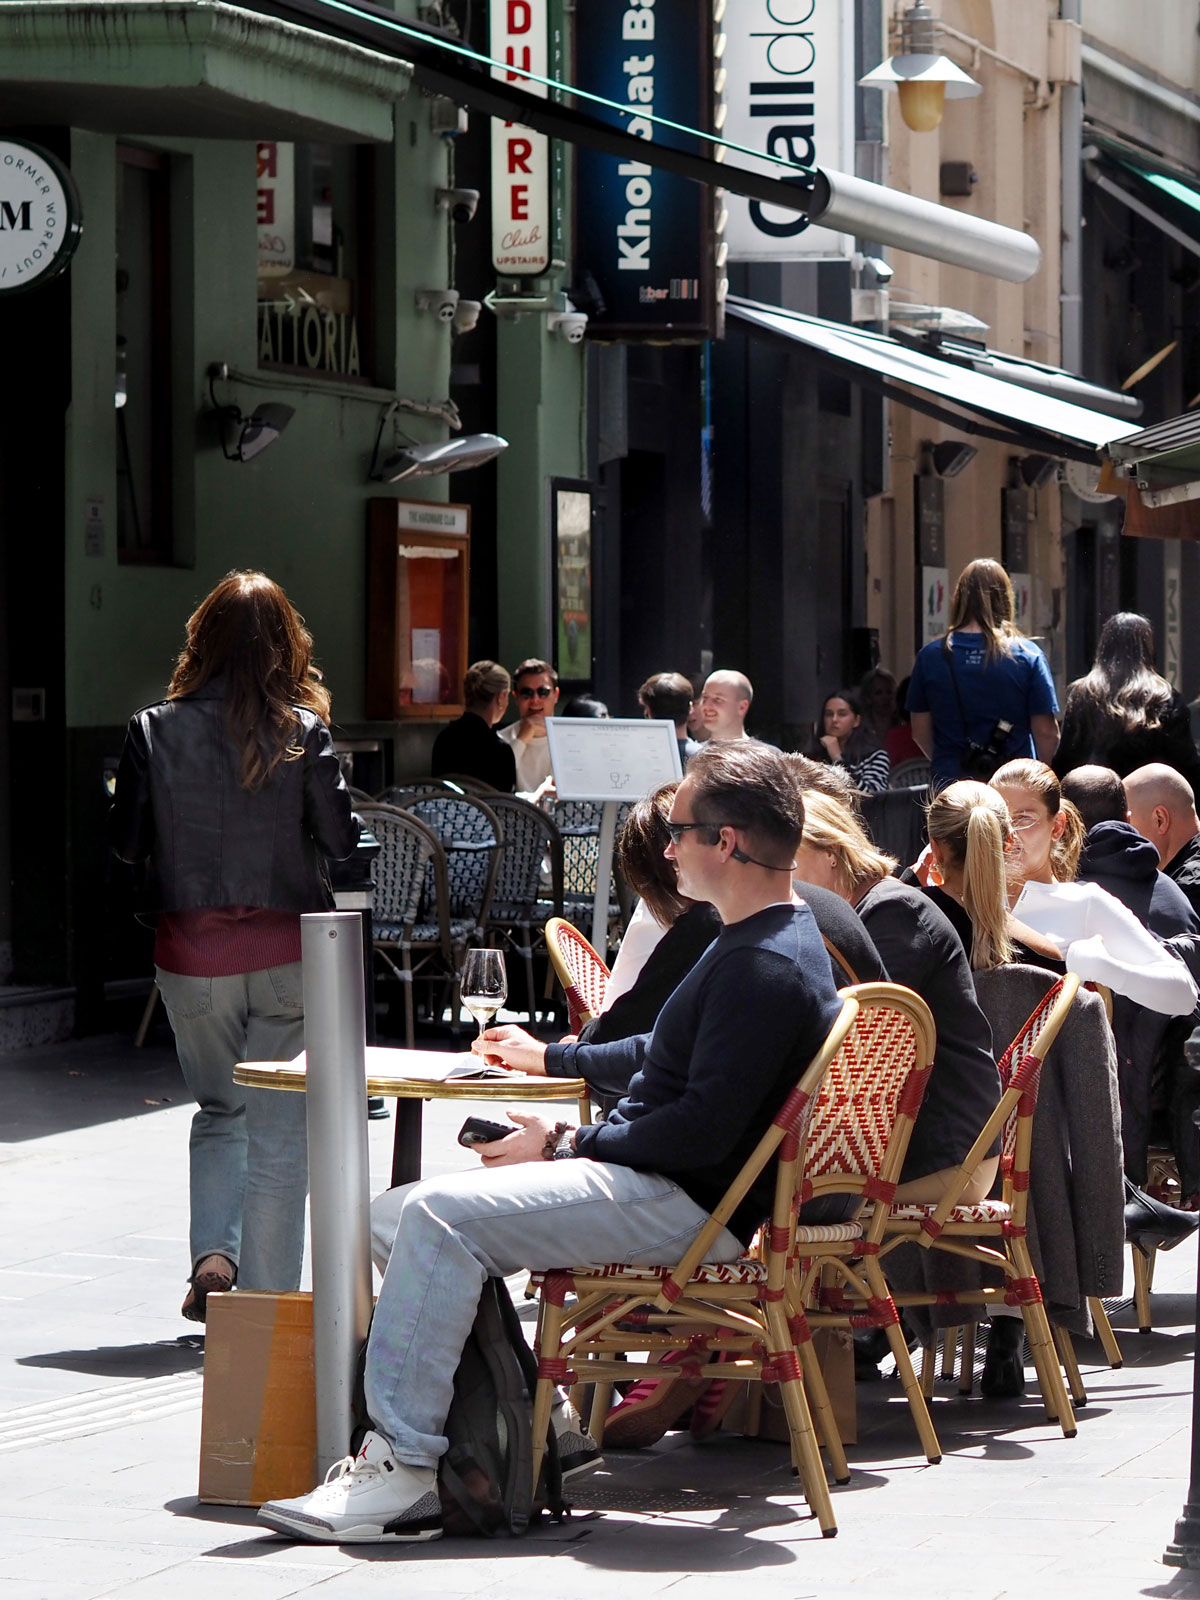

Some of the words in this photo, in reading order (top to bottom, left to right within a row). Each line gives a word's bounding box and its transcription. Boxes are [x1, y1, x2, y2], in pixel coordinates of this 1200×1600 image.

[505, 0, 532, 221] DWRE
[0, 152, 50, 195] ORMER
[16, 201, 56, 274] WORKOUT
[501, 225, 542, 250] Club
[496, 256, 545, 265] UPSTAIRS
